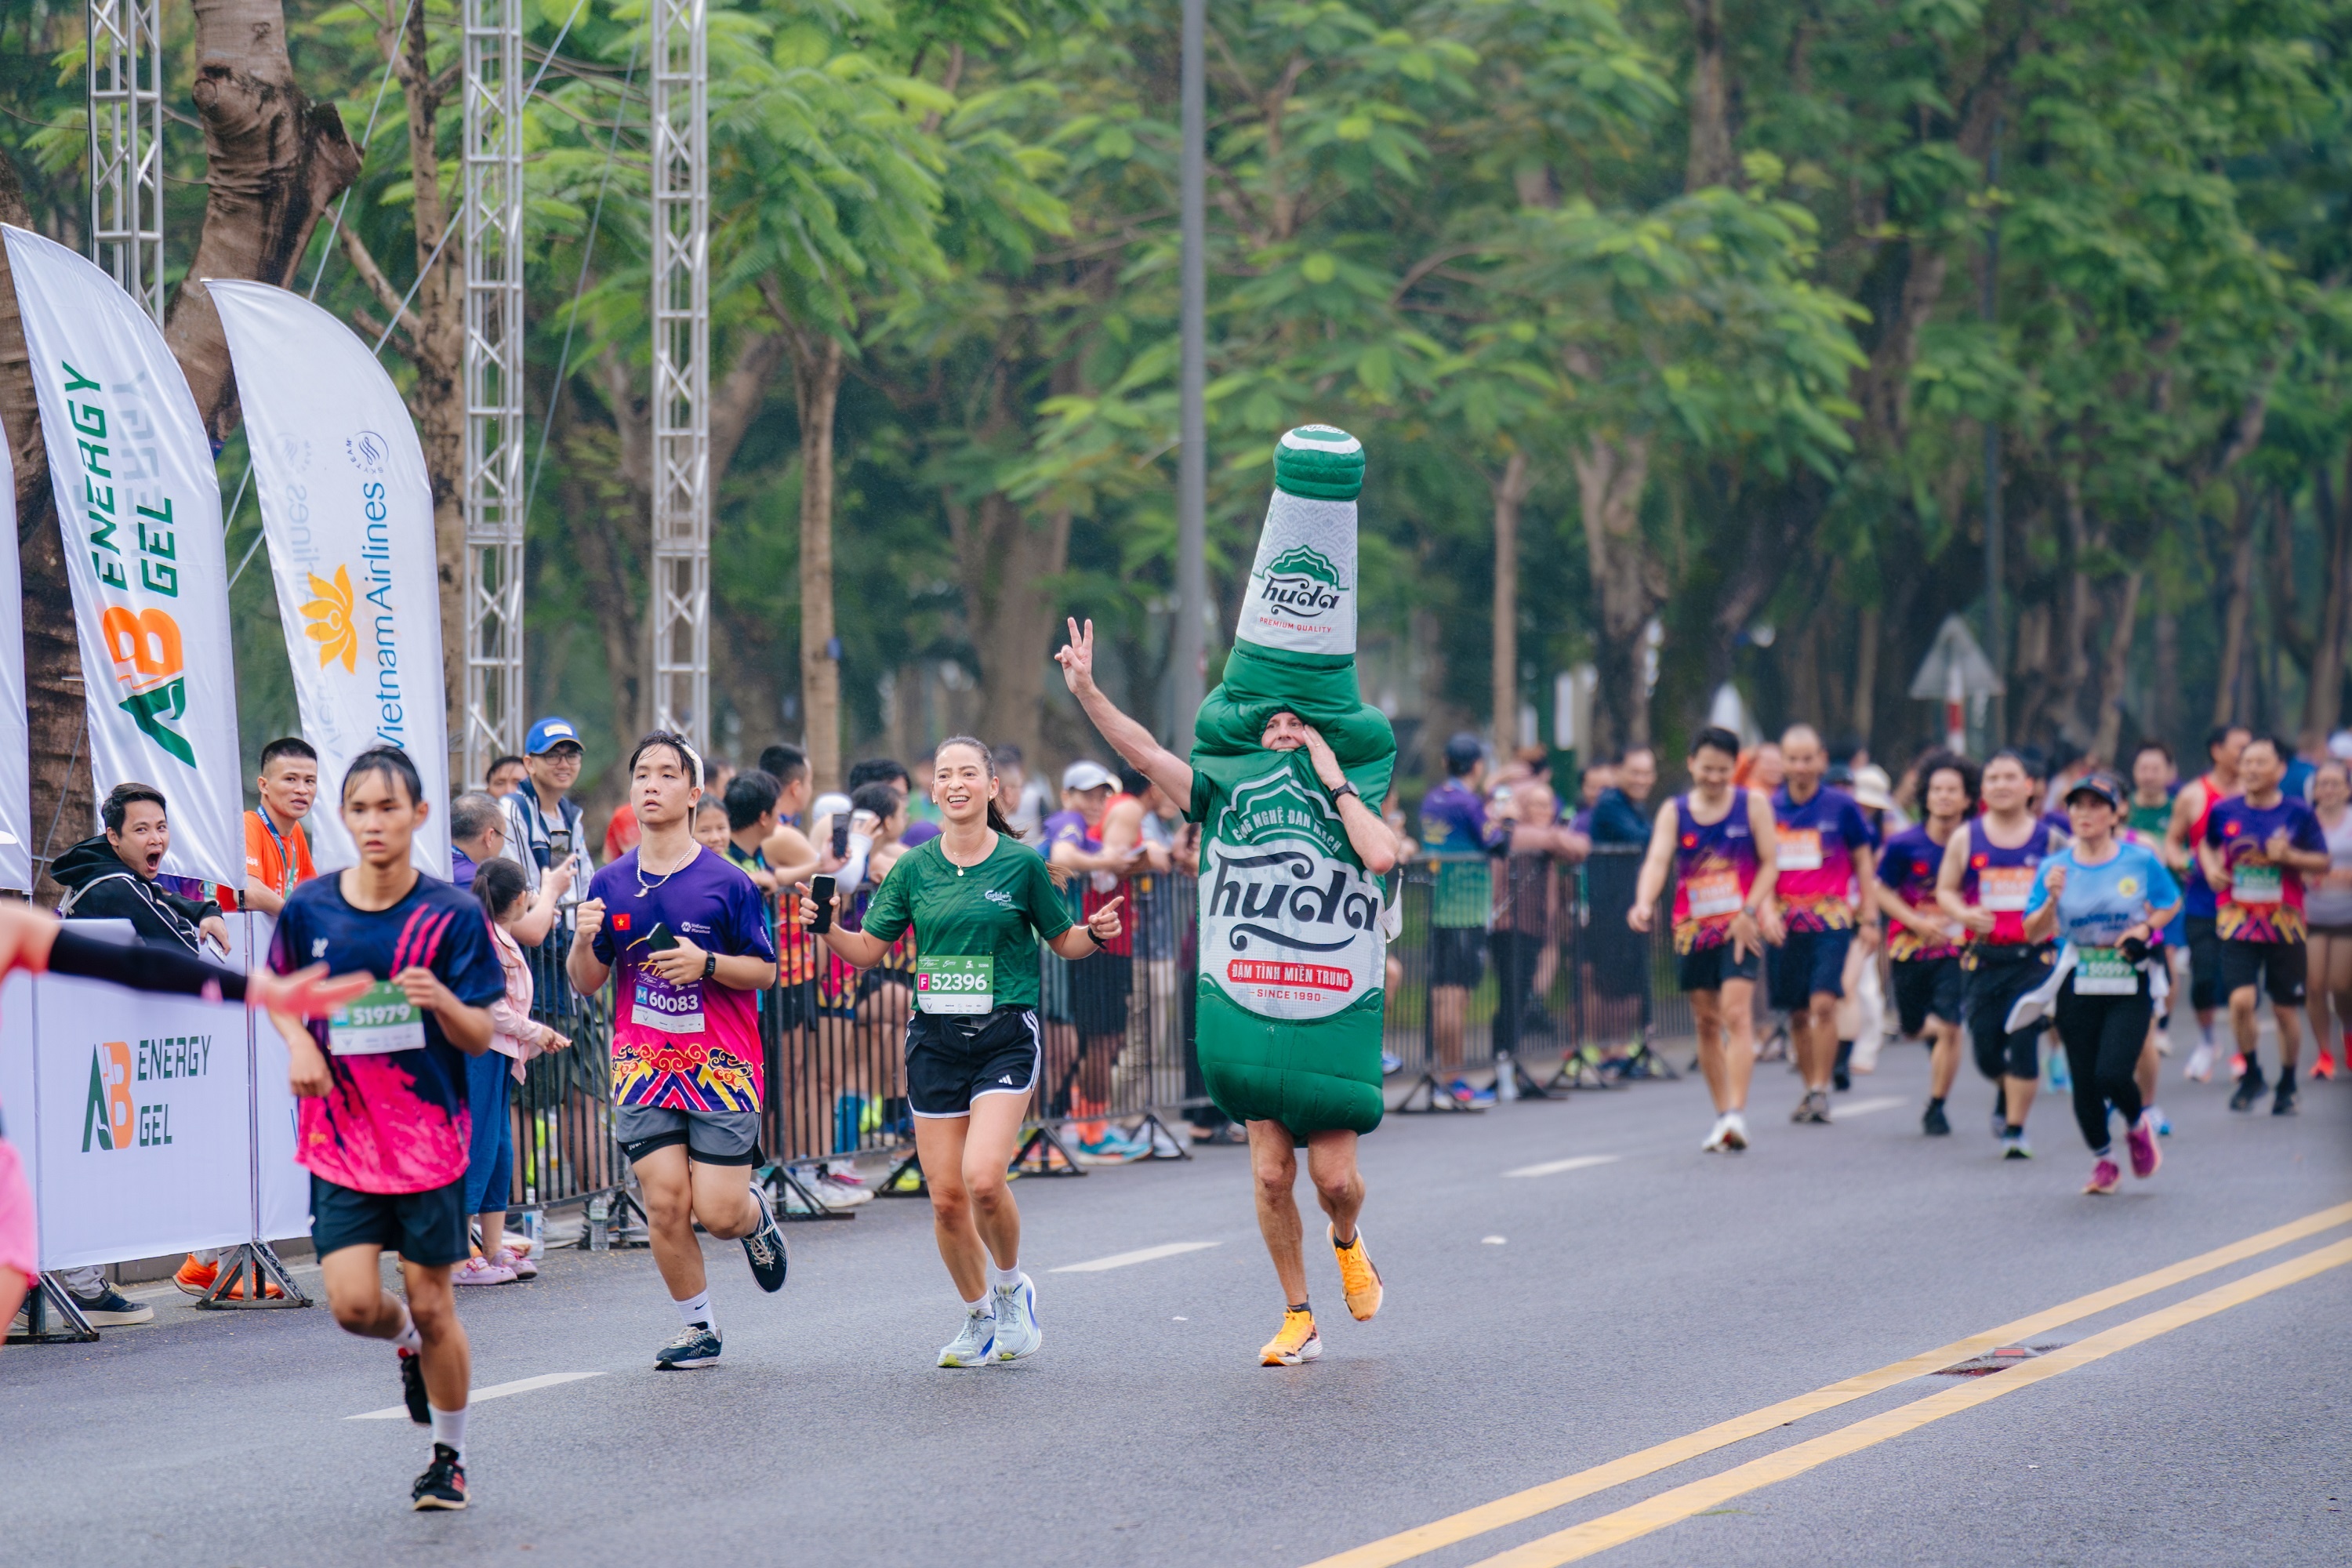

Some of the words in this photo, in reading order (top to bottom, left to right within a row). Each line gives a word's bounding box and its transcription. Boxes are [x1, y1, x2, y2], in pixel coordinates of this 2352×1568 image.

[346, 437, 384, 474] SKYTEAM
[62, 360, 128, 592] ENERGY
[136, 497, 178, 598] GEL
[361, 482, 392, 611] Airlines
[1261, 574, 1340, 609] huda
[1259, 617, 1294, 630] PREMIUM
[1297, 624, 1331, 633] QUALITY
[1252, 806, 1284, 828] NGHỆ
[1287, 810, 1311, 829] ĐAN
[1209, 849, 1378, 931] huda
[920, 978, 927, 988] F
[931, 973, 988, 991] 52396
[1232, 961, 1252, 980] ĐẬM
[1256, 963, 1280, 981] TÌNH
[1284, 964, 1313, 983] MIỀN
[1316, 970, 1348, 988] TRUNG
[637, 989, 647, 1000] M
[648, 991, 699, 1013] 60083
[1257, 989, 1290, 1000] SINCE
[1294, 992, 1321, 1001] 1990
[352, 1004, 412, 1025] 51979
[138, 1035, 212, 1081] ENERGY
[140, 1104, 172, 1147] GEL
